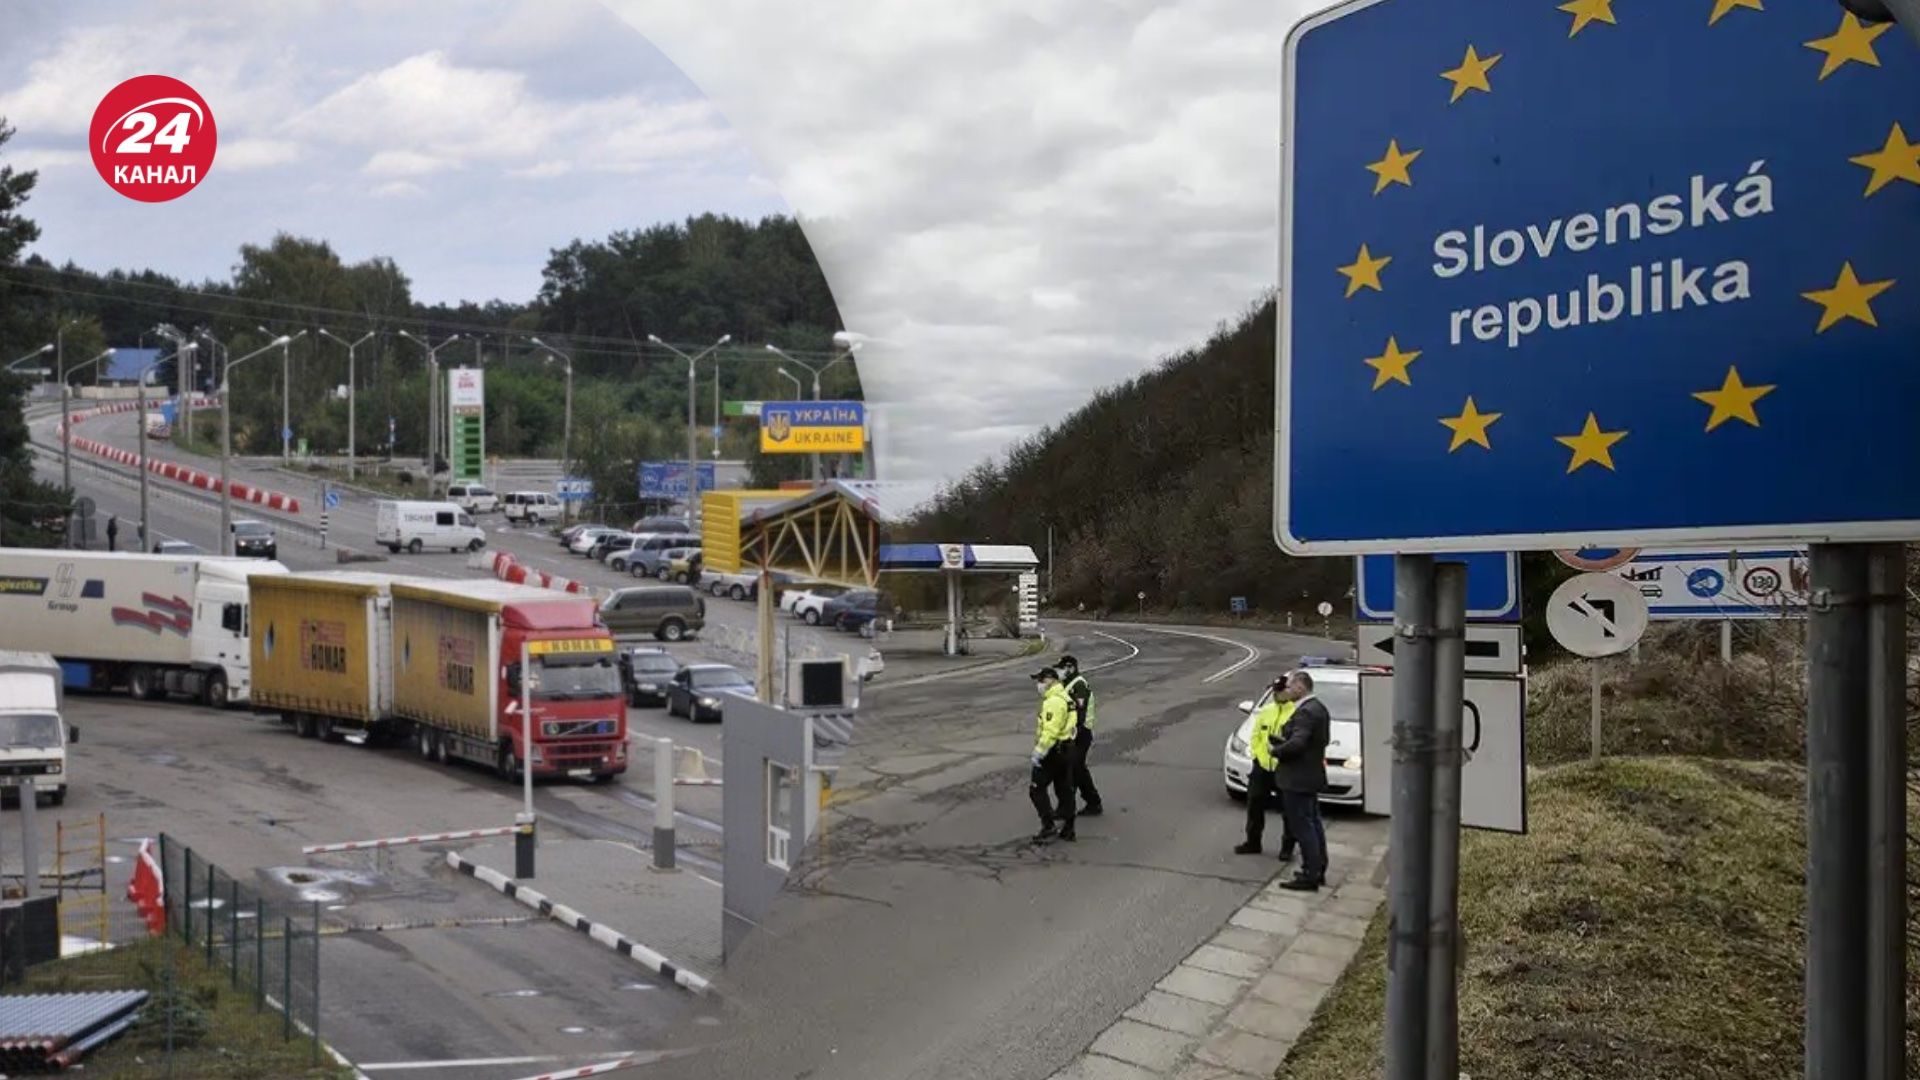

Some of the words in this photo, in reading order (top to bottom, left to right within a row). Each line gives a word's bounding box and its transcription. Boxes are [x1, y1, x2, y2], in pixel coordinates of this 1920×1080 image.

[1433, 159, 1774, 278] Slovenská
[1450, 258, 1751, 348] republika
[795, 407, 858, 422] УКРАЇНА
[794, 431, 854, 443] UKRAINE
[48, 600, 79, 613] Group
